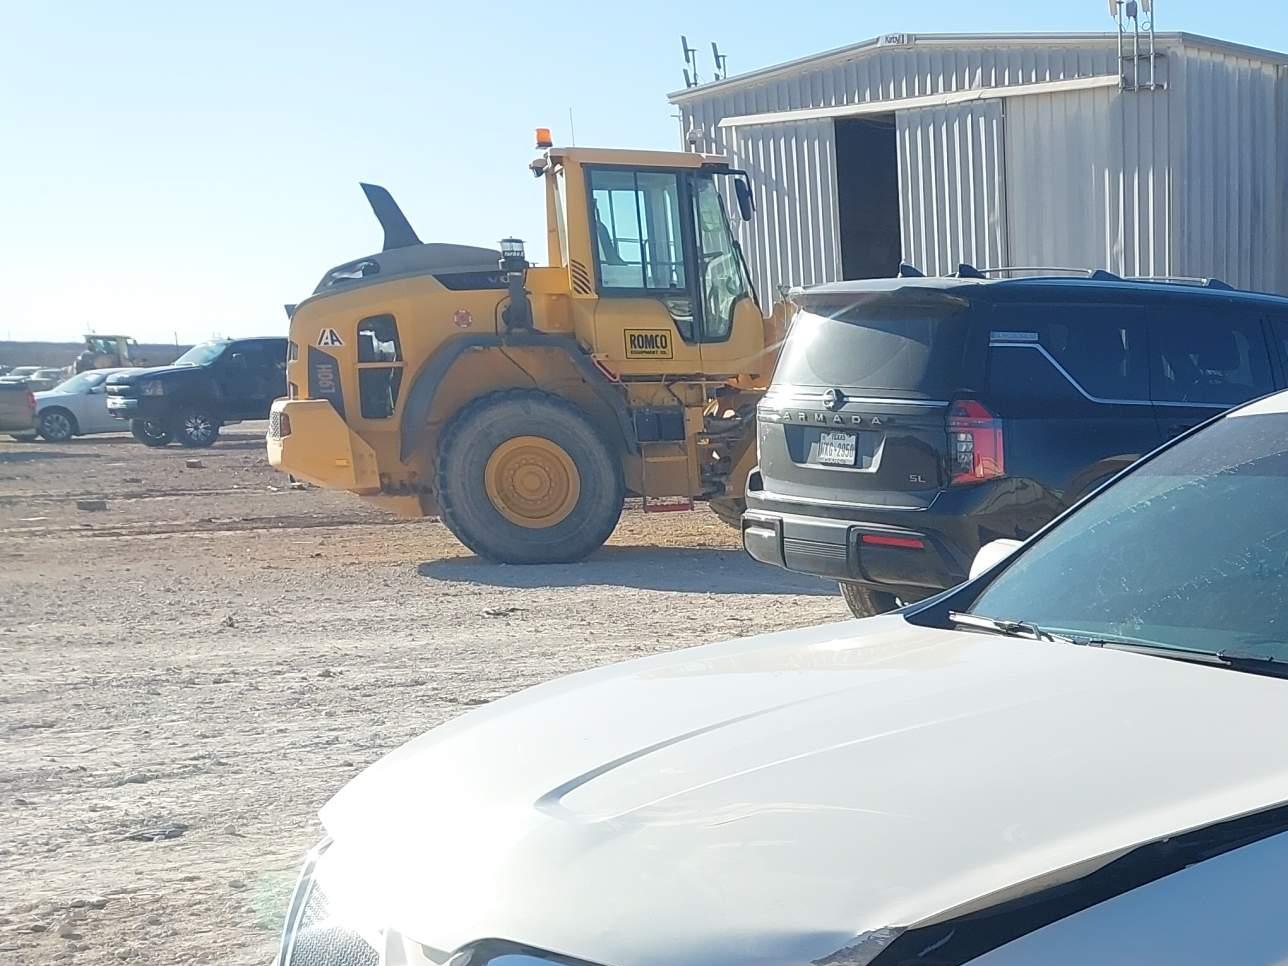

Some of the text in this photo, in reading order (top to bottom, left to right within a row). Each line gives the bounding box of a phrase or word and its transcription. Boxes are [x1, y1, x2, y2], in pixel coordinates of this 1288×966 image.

[629, 334, 668, 349] ROMCO
[316, 363, 336, 393] L90H
[783, 412, 882, 425] ARMADA
[909, 474, 926, 483] SL
